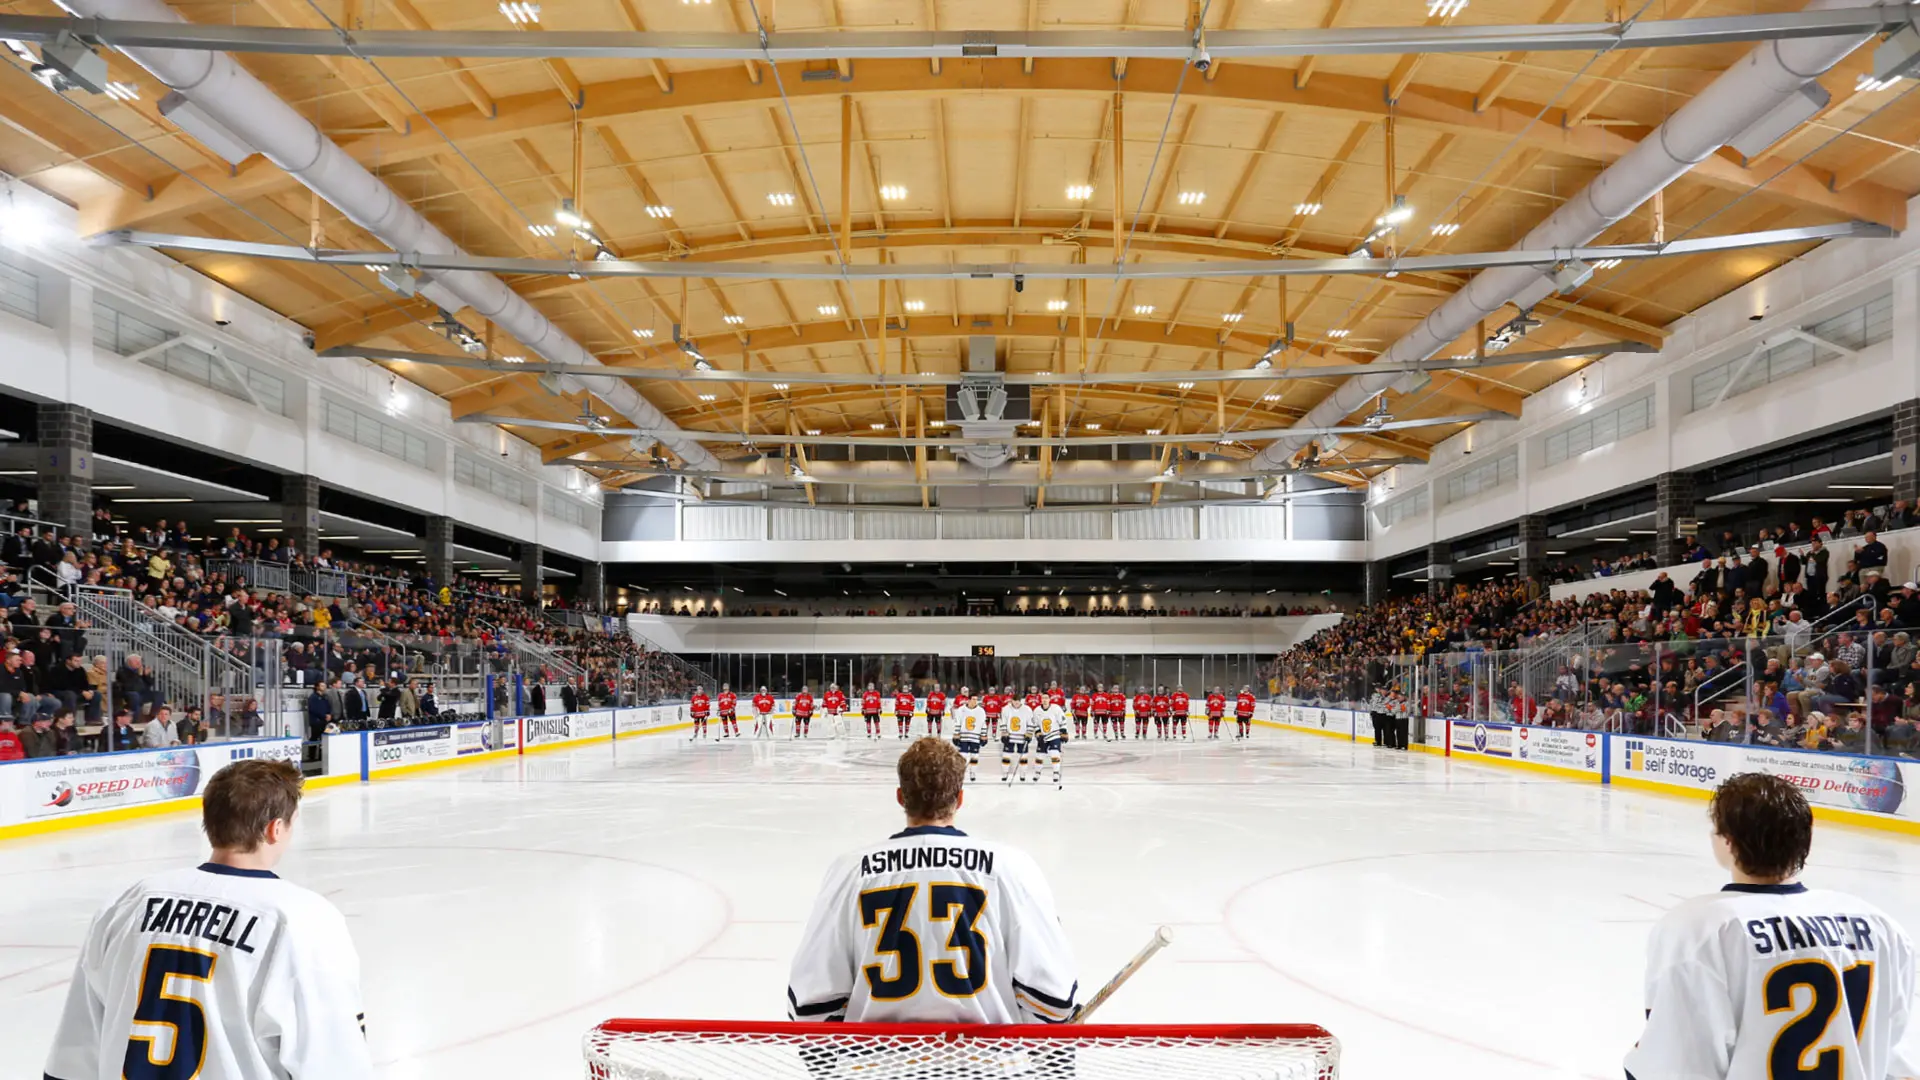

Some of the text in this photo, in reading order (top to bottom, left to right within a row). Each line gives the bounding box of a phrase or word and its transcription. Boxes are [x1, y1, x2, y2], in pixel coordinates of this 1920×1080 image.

[79, 457, 86, 469] 3
[1900, 454, 1907, 466] 9
[527, 716, 570, 743] CANISIUS
[1645, 745, 1695, 760] Uncle Bob's
[35, 766, 68, 779] Around
[69, 765, 82, 775] the
[83, 765, 107, 774] corner
[108, 763, 118, 772] or
[118, 761, 144, 771] around
[1645, 758, 1716, 783] self storage
[76, 773, 189, 796] SPEED Delivers!
[1823, 779, 1888, 798] Delivers!
[861, 847, 994, 877] ASMUNDSON
[140, 897, 259, 954] FARRELL
[1747, 915, 1875, 954] STANDER
[858, 881, 988, 1002] 33
[121, 943, 218, 1080] 5
